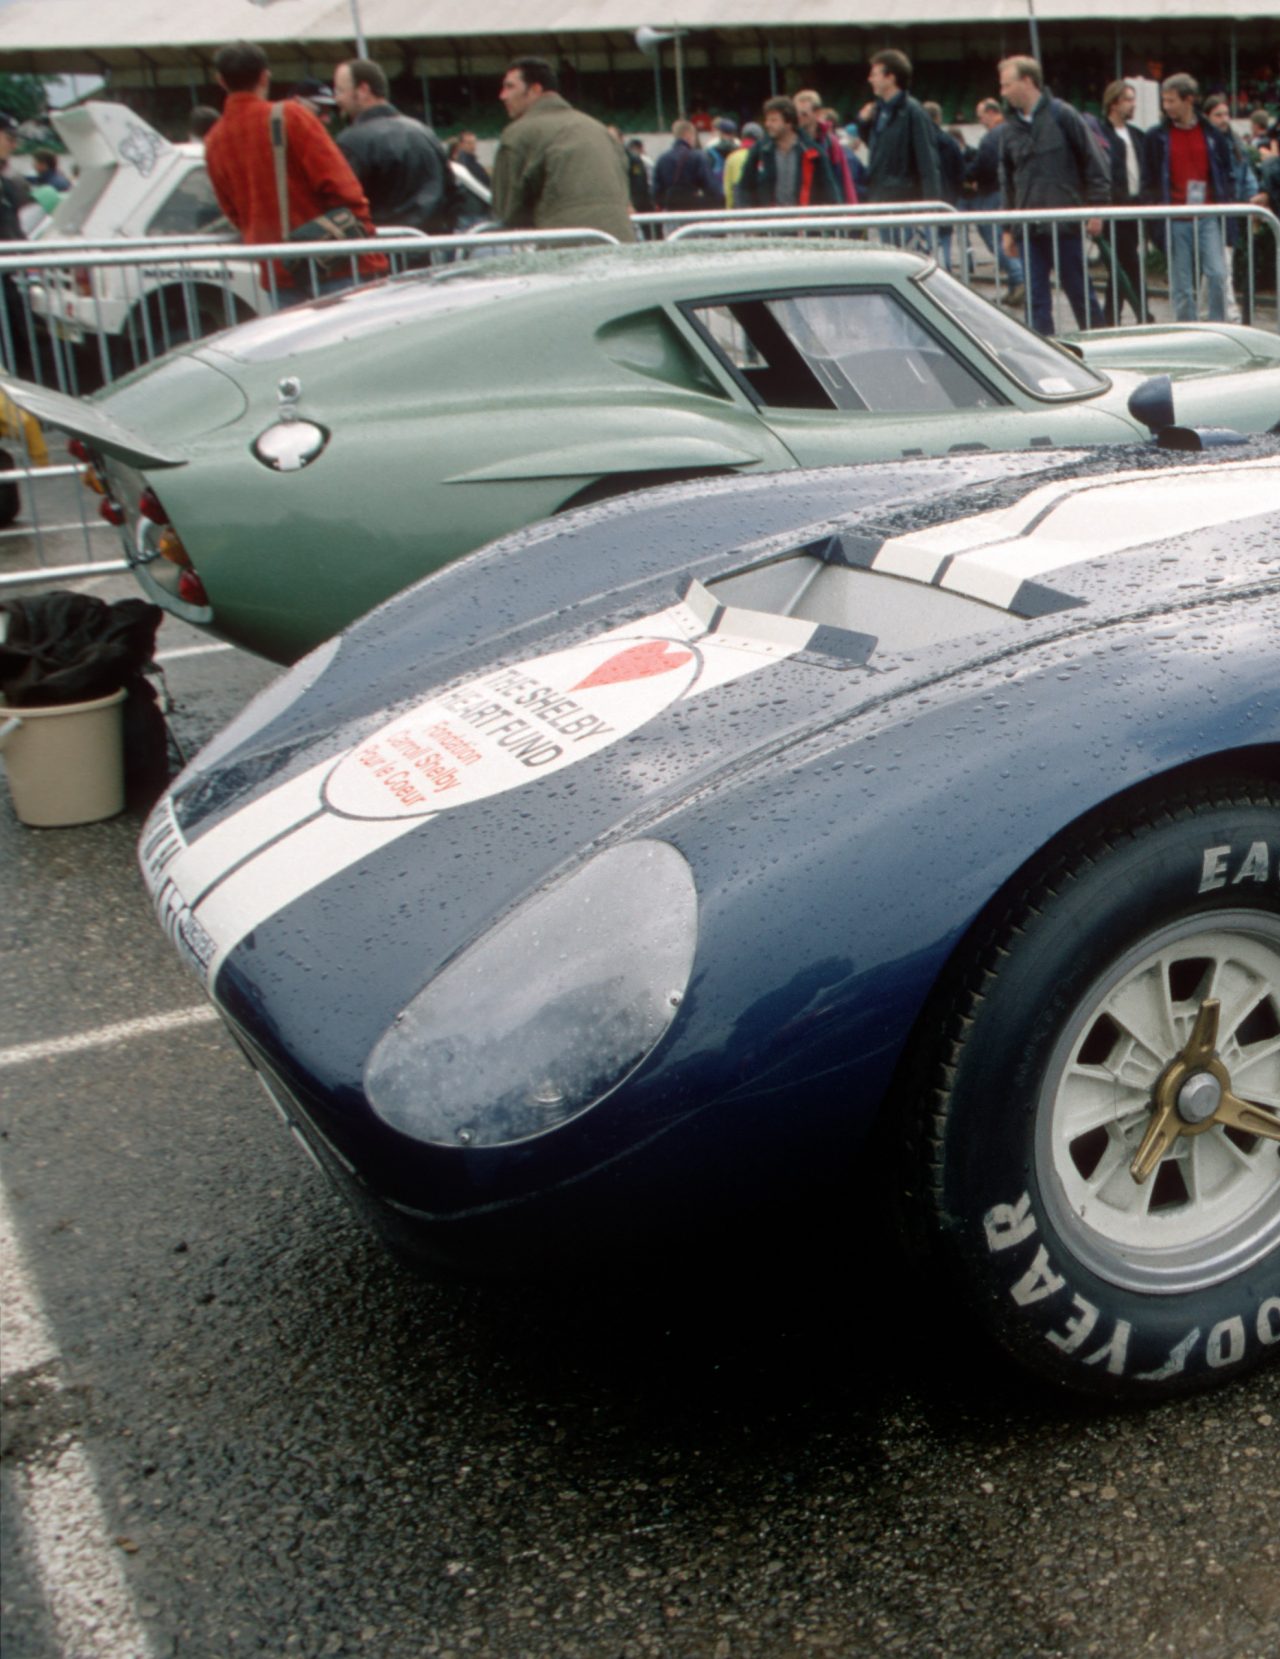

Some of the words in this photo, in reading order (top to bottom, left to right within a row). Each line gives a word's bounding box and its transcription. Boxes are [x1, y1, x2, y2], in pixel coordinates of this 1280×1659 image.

[436, 688, 515, 729] HEART
[485, 718, 564, 768] FUND
[483, 668, 539, 698] THE
[514, 686, 616, 744] SHELBY
[383, 770, 427, 807] Coeur
[414, 752, 462, 794] Shelby
